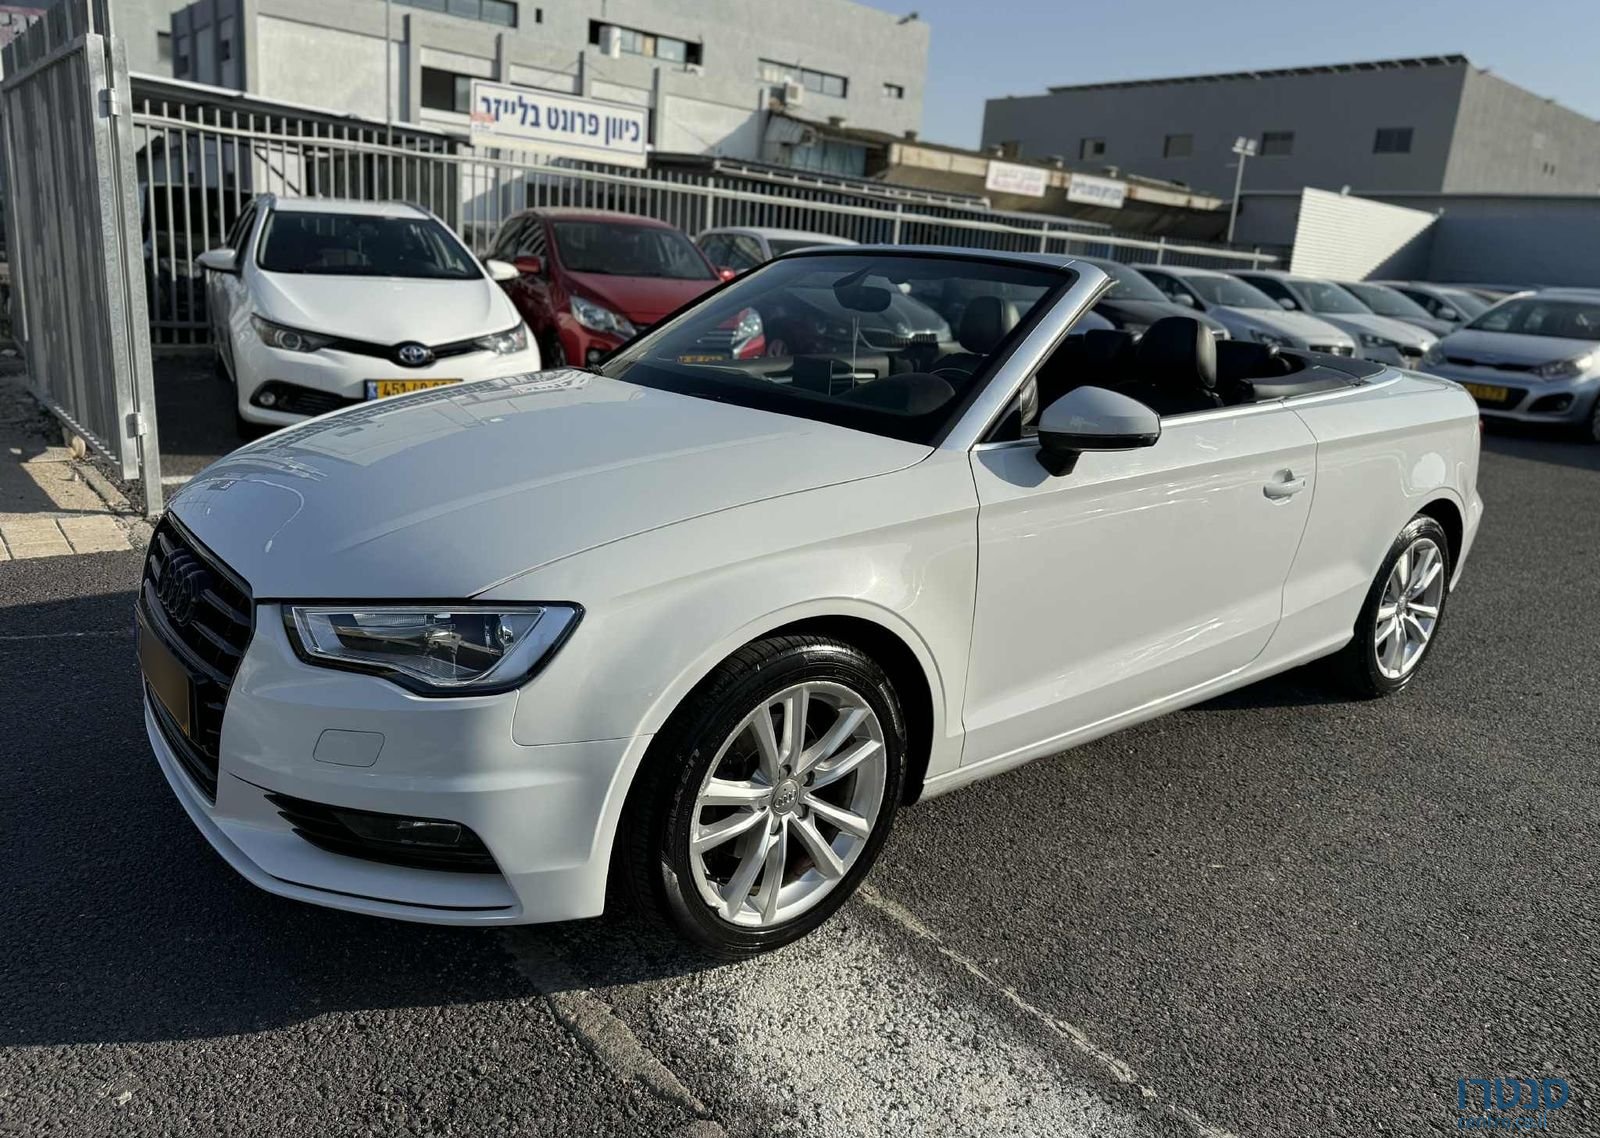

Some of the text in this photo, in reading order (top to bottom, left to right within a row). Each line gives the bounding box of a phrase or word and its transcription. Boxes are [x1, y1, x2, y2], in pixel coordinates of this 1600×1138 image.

[480, 95, 640, 146] כיוון פרונט בלייזר
